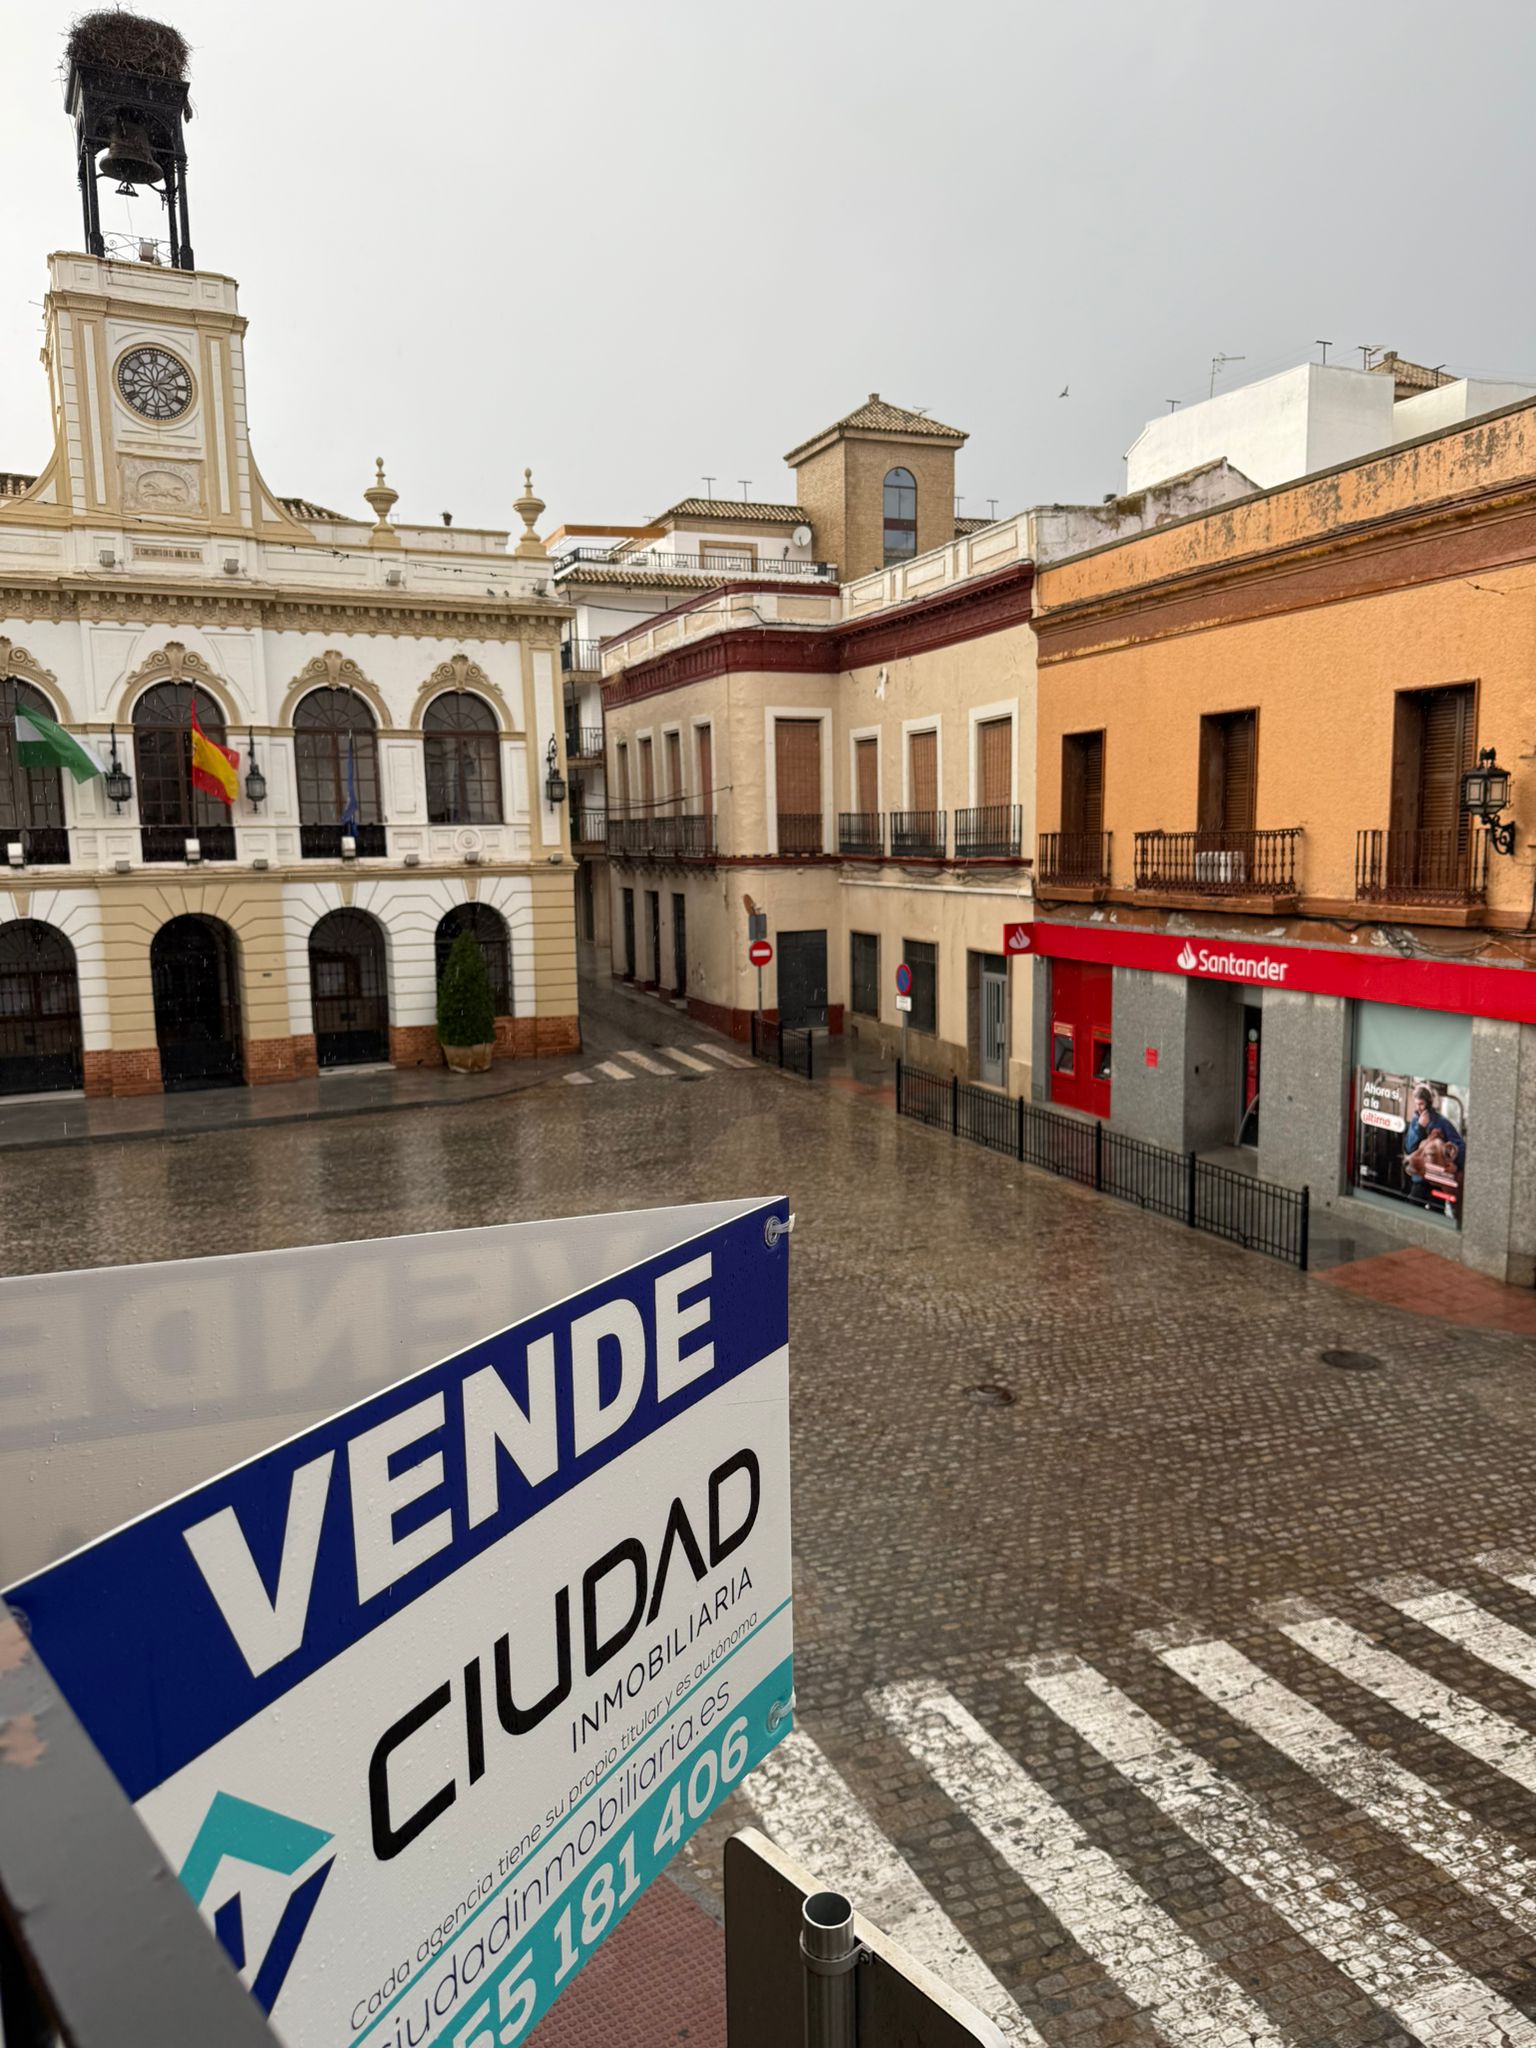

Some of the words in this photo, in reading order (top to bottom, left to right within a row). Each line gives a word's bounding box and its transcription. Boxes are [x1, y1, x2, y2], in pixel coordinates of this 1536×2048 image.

[1198, 949, 1288, 981] Santander
[1364, 1081, 1391, 1098] Ahora
[1363, 1098, 1370, 1107] a
[182, 1252, 714, 1678] VENDE
[369, 1448, 760, 1861] CIUDAD
[573, 1567, 752, 1753] INMOBILIARIA
[351, 1960, 410, 2030] Cada
[417, 1872, 493, 1962] agencia
[499, 1824, 541, 1876] tiene
[545, 1799, 564, 1828] su
[569, 1747, 617, 1810] propio
[621, 1701, 664, 1750] titular
[664, 1691, 673, 1712] y
[675, 1674, 691, 1697] es
[694, 1612, 757, 1679] autónoma
[382, 1681, 729, 2048] iudadinmobiliaria.es
[553, 1831, 641, 1988] 181
[653, 1716, 748, 1856] 406
